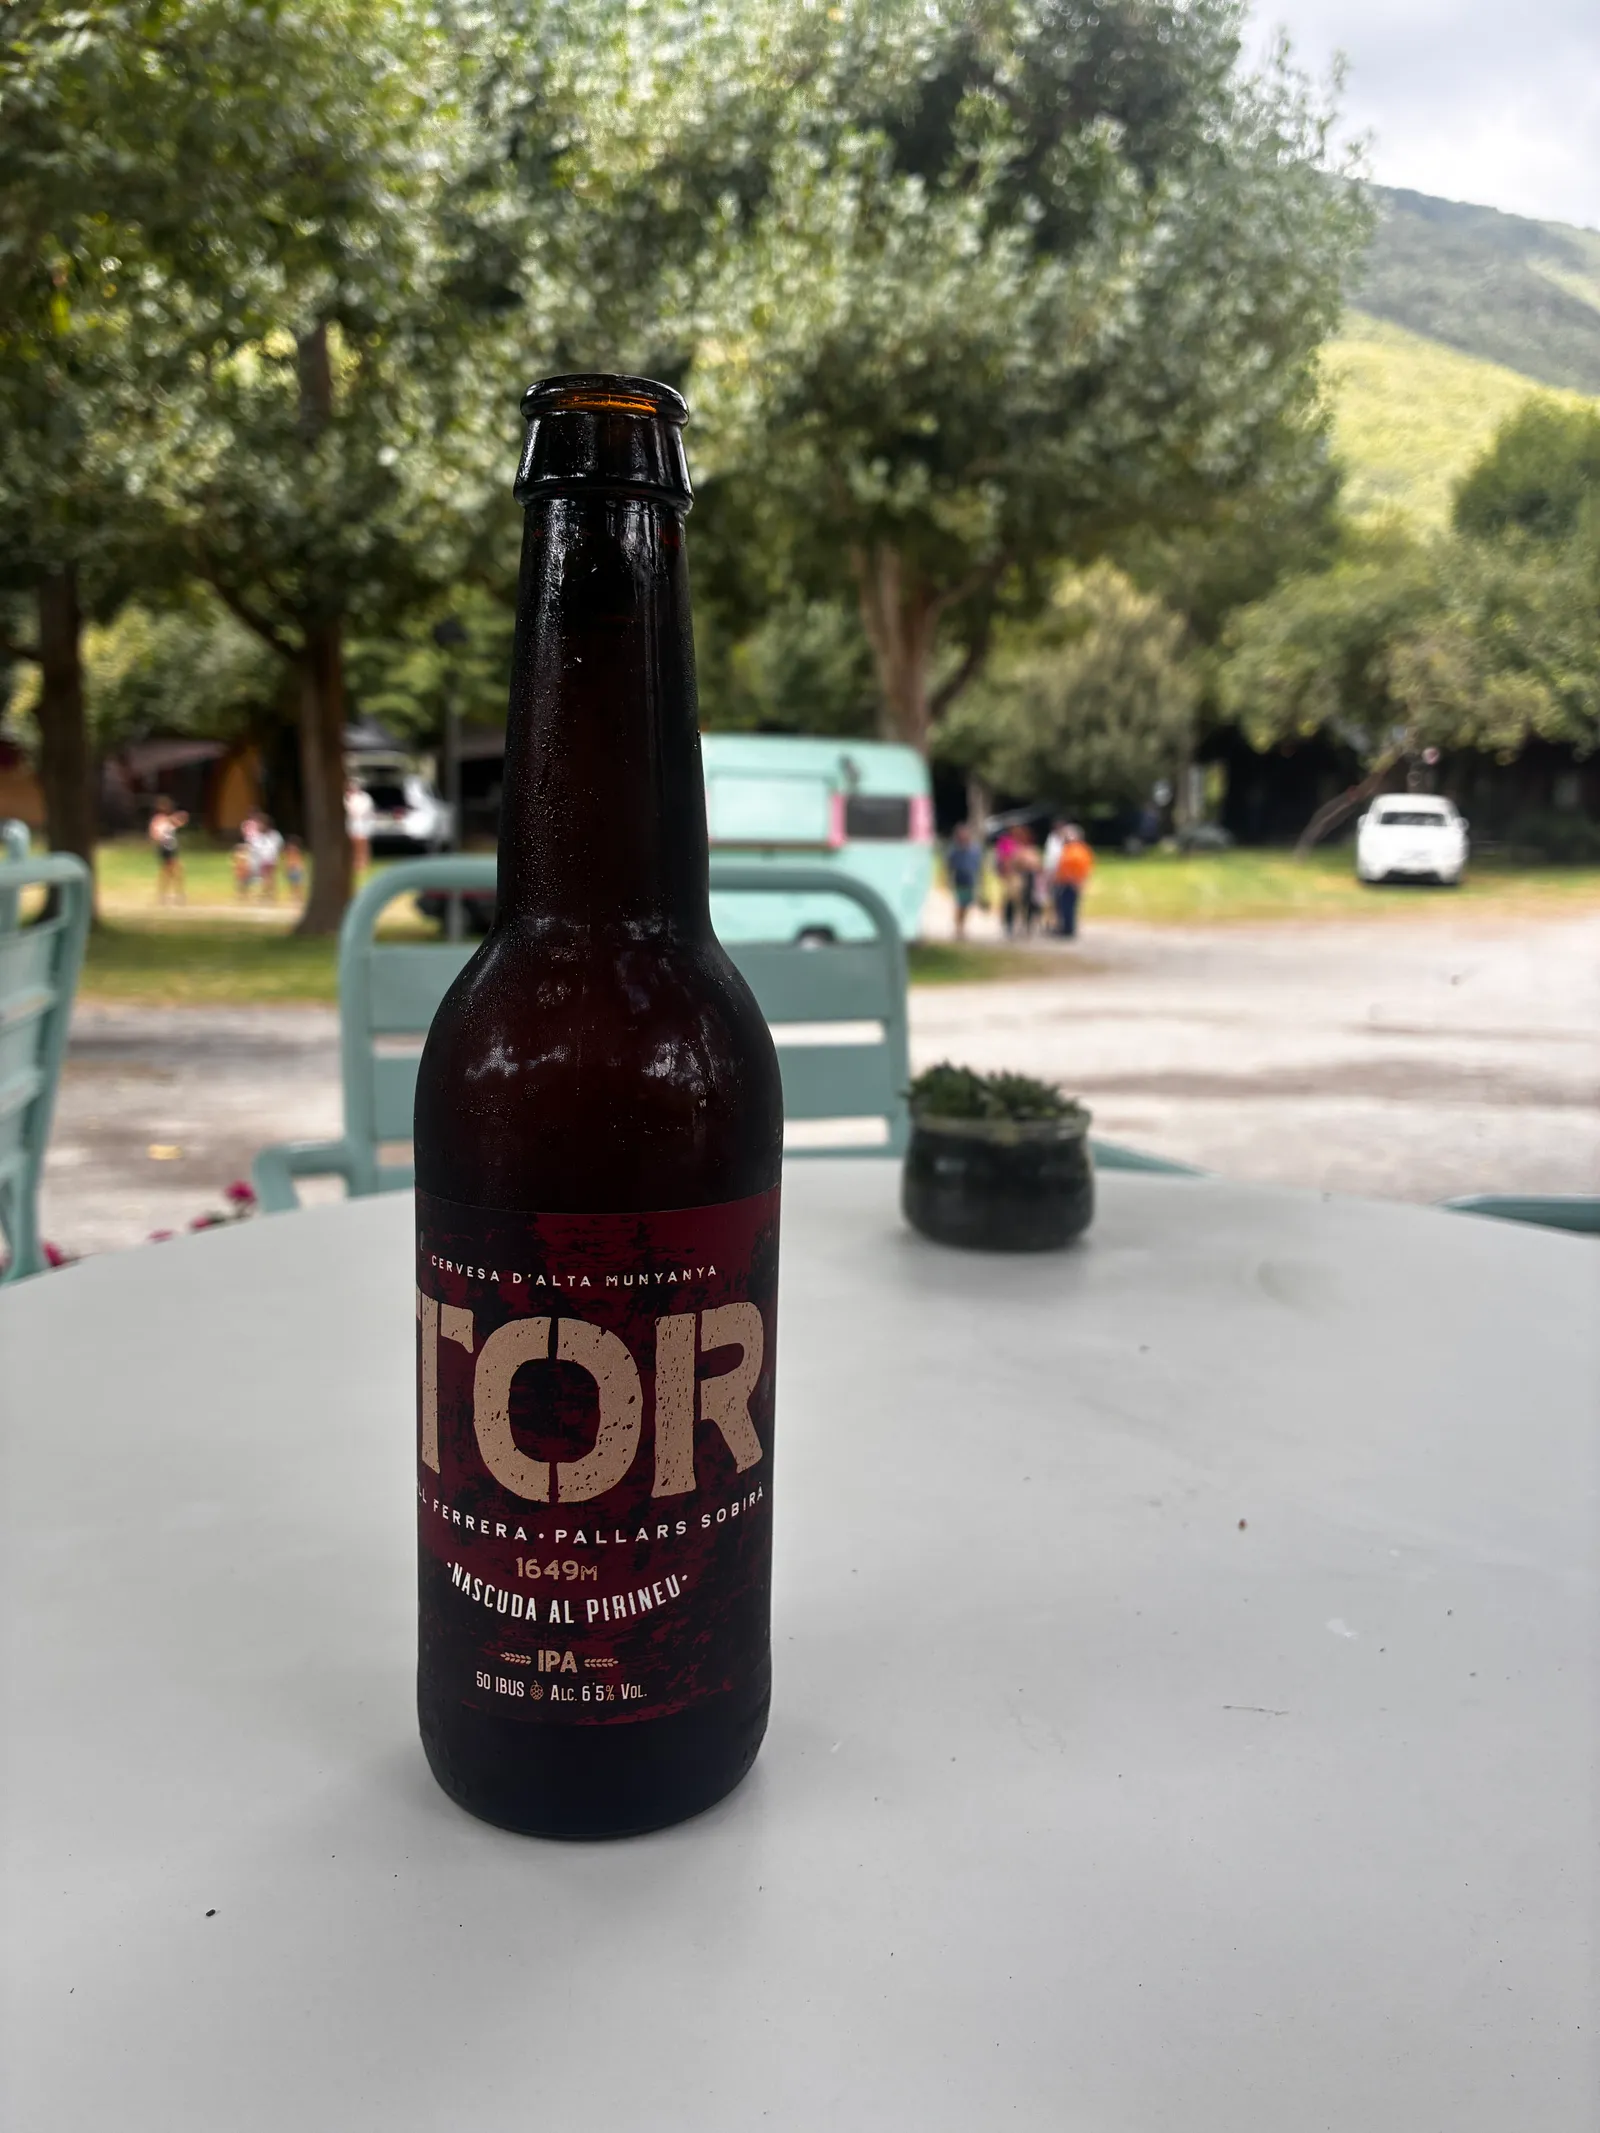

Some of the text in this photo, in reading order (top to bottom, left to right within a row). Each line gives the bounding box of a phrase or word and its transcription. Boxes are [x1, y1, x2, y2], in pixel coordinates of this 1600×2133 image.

[431, 1254, 717, 1287] CERVESA D'ALTA MUNYANYA
[416, 1284, 764, 1503] TOR
[433, 1498, 528, 1541] FERRERA
[555, 1520, 687, 1544] PALLARS
[549, 1600, 574, 1623] AL
[537, 1650, 578, 1673] IPA
[476, 1670, 491, 1690] 50
[495, 1676, 525, 1697] IBUS
